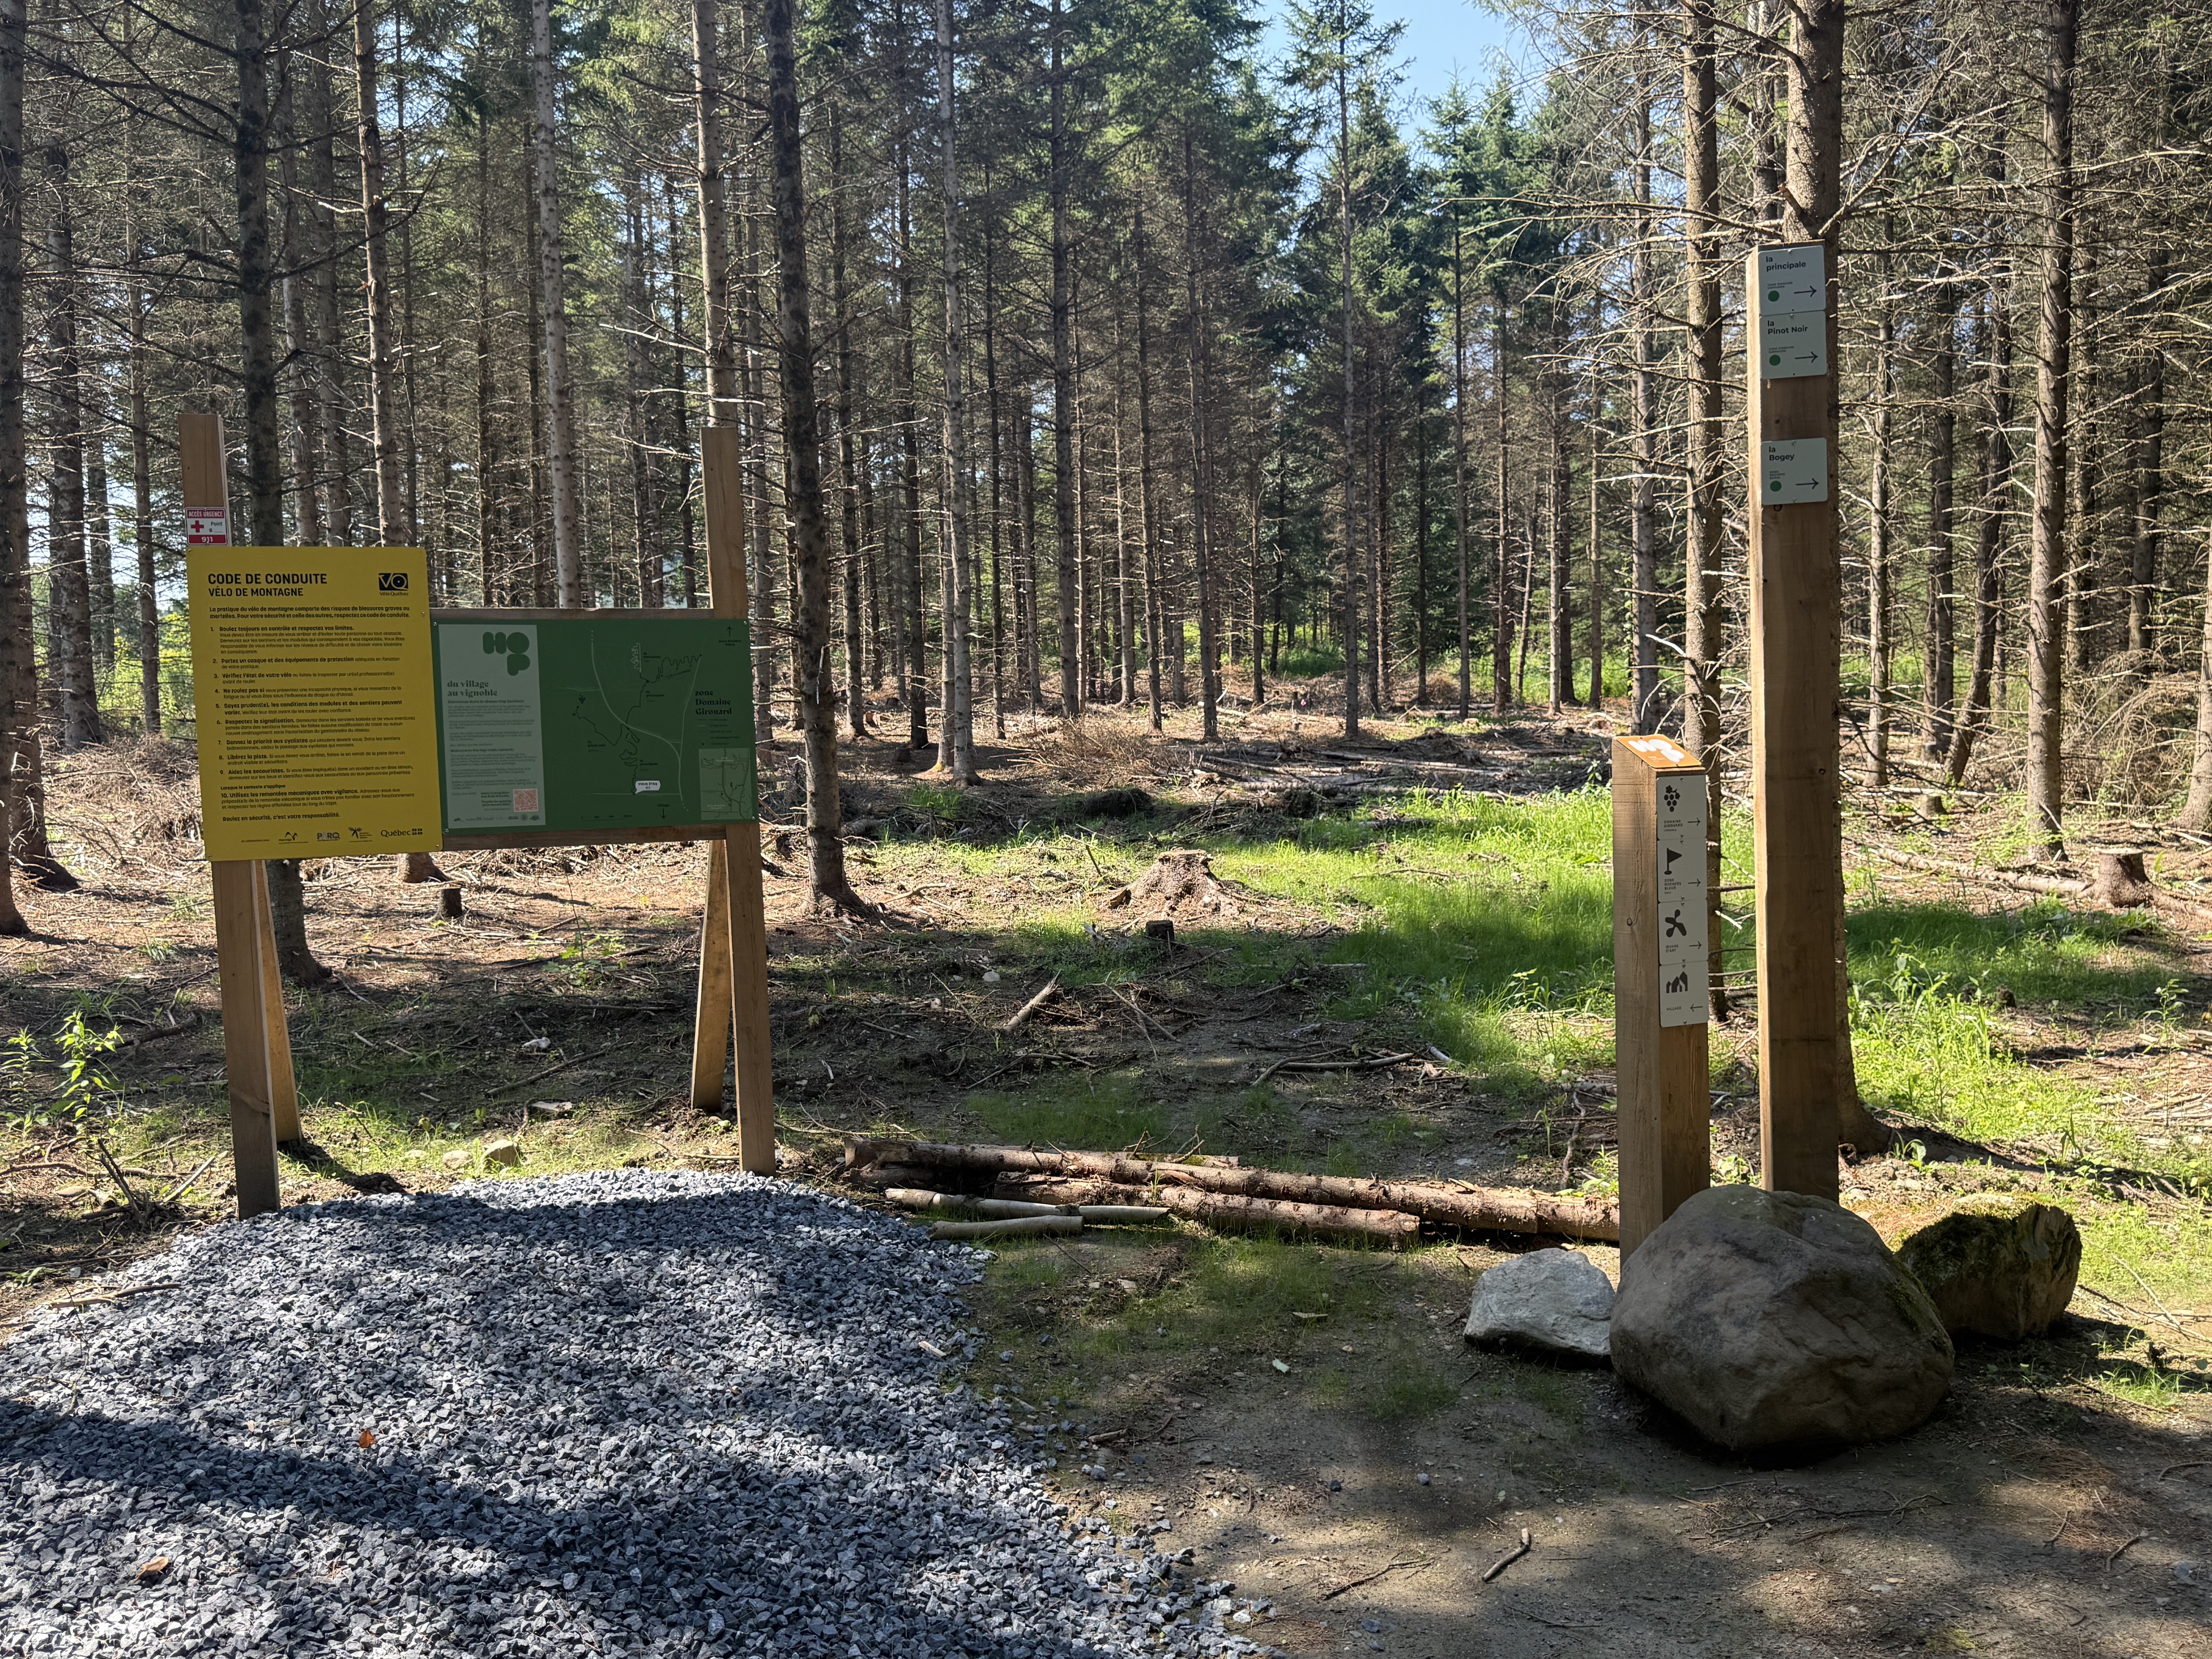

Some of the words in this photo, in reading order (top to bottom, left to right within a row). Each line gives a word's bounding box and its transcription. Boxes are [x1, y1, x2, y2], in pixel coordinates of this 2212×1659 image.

[1766, 261, 1806, 272] principale
[1768, 326, 1789, 335] Pinot
[208, 574, 241, 584] CODE
[246, 574, 261, 584] DE
[265, 574, 327, 584] CONDUITE
[209, 586, 232, 596] VÉLO
[236, 588, 248, 596] DE
[252, 588, 303, 596] MONTAGNE
[460, 680, 489, 689] village
[460, 689, 497, 698] vignoble
[381, 830, 410, 838] Québec
